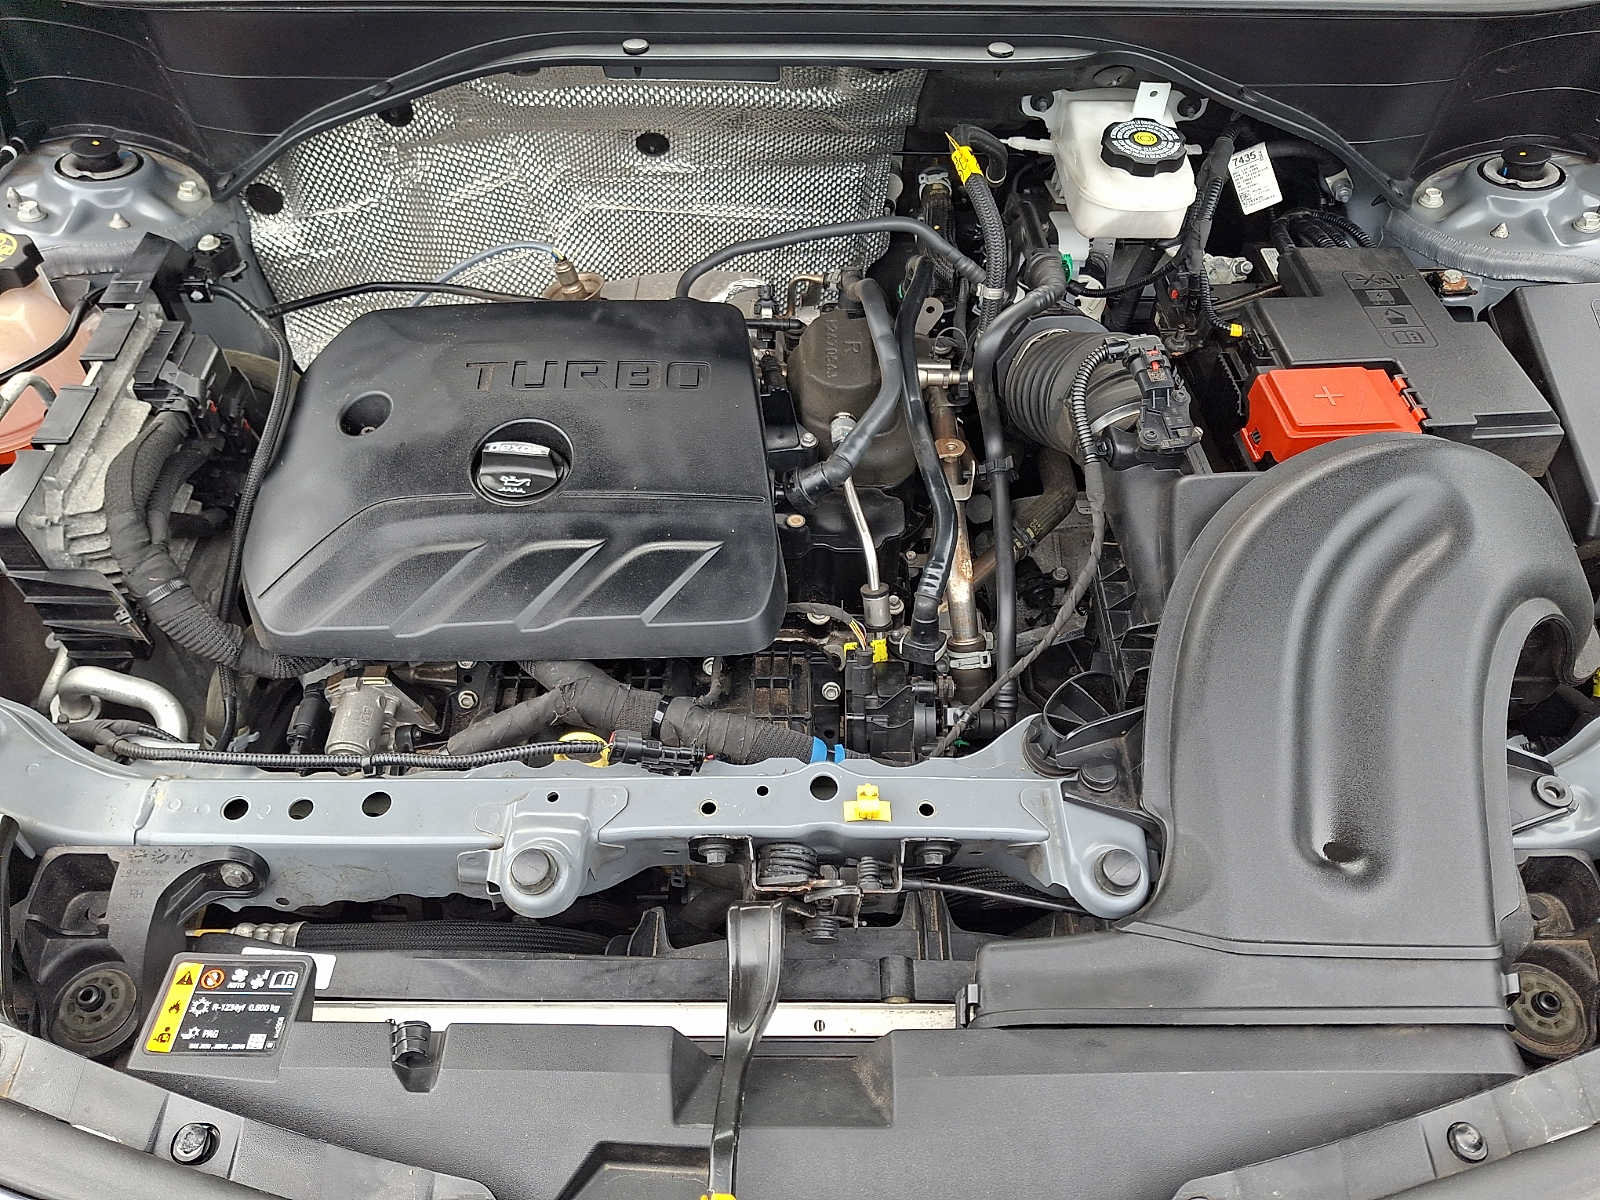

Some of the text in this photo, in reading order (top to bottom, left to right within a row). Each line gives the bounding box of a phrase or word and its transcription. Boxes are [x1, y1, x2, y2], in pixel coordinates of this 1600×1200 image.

[1231, 150, 1257, 167] 7435
[466, 360, 712, 392] TURBO
[202, 1030, 219, 1038] PAG
